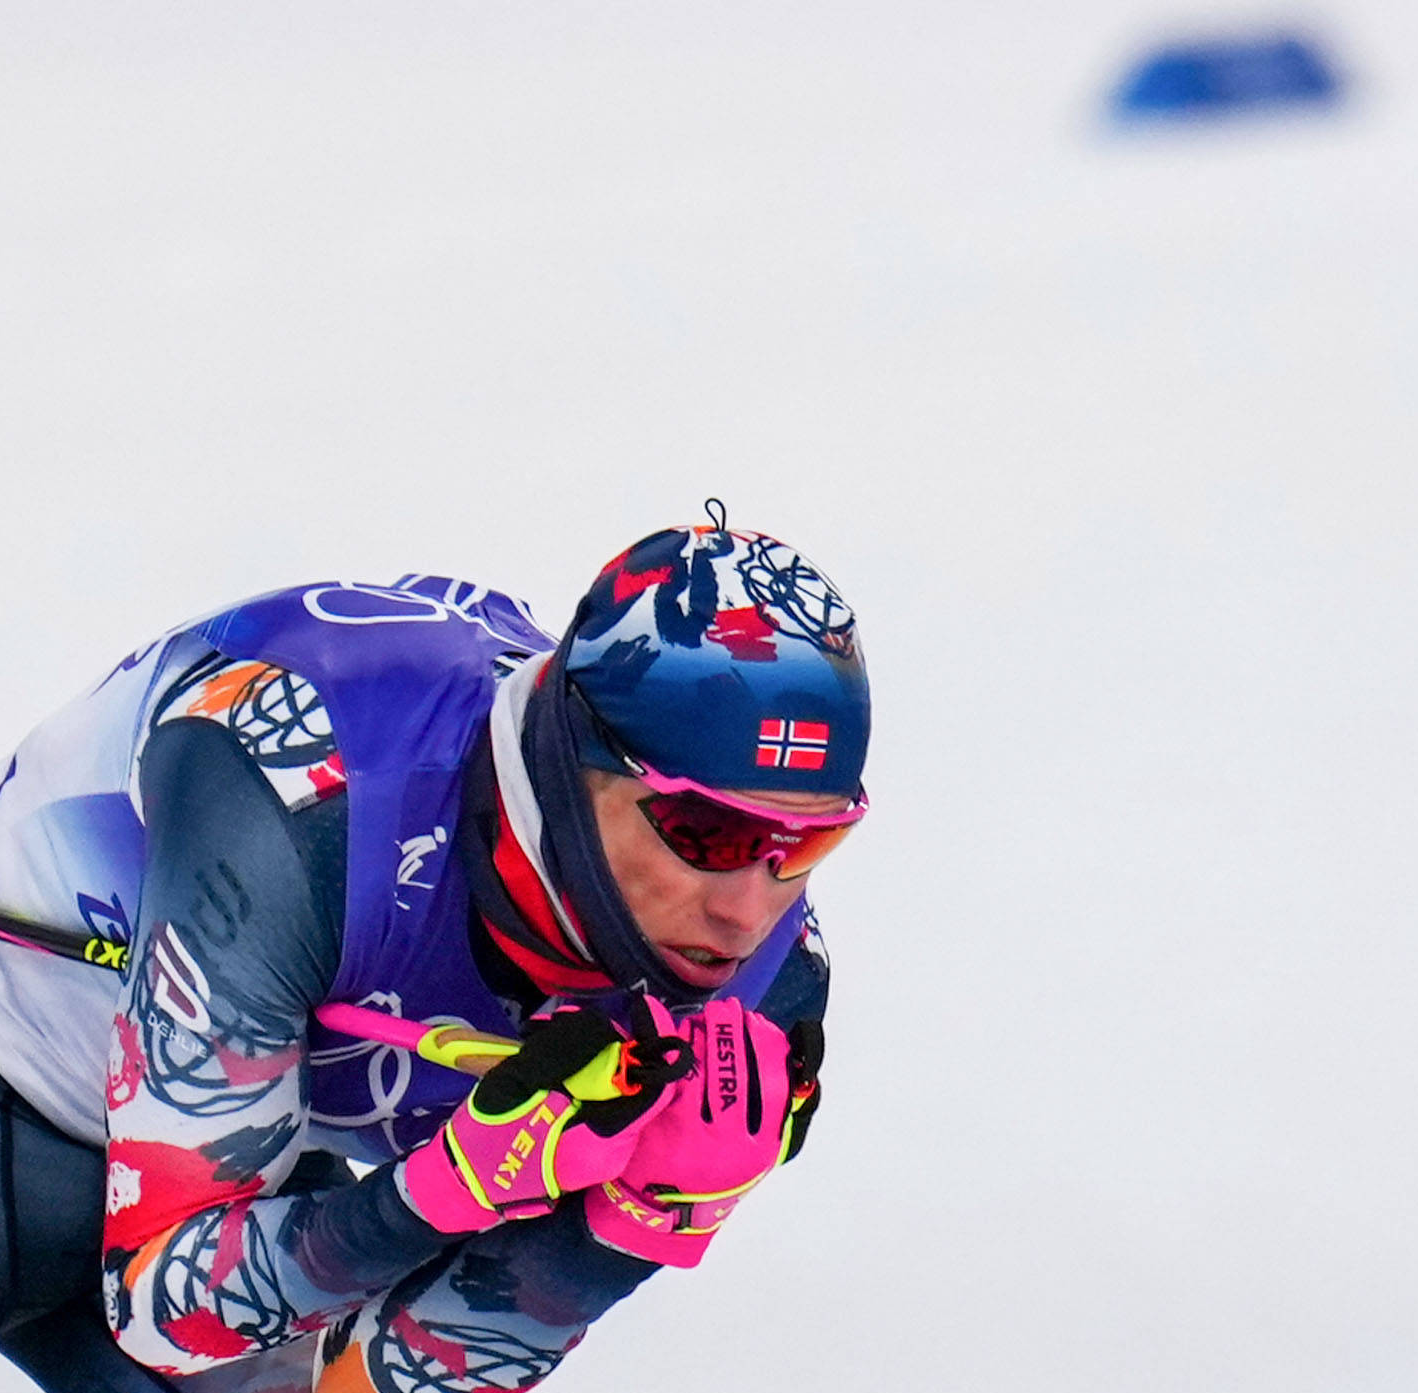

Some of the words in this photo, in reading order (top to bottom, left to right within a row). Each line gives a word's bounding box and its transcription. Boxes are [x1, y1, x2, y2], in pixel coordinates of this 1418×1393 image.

[716, 1023, 738, 1112] HESTRA
[493, 1104, 556, 1190] LEKI
[602, 1181, 665, 1228] EKI
